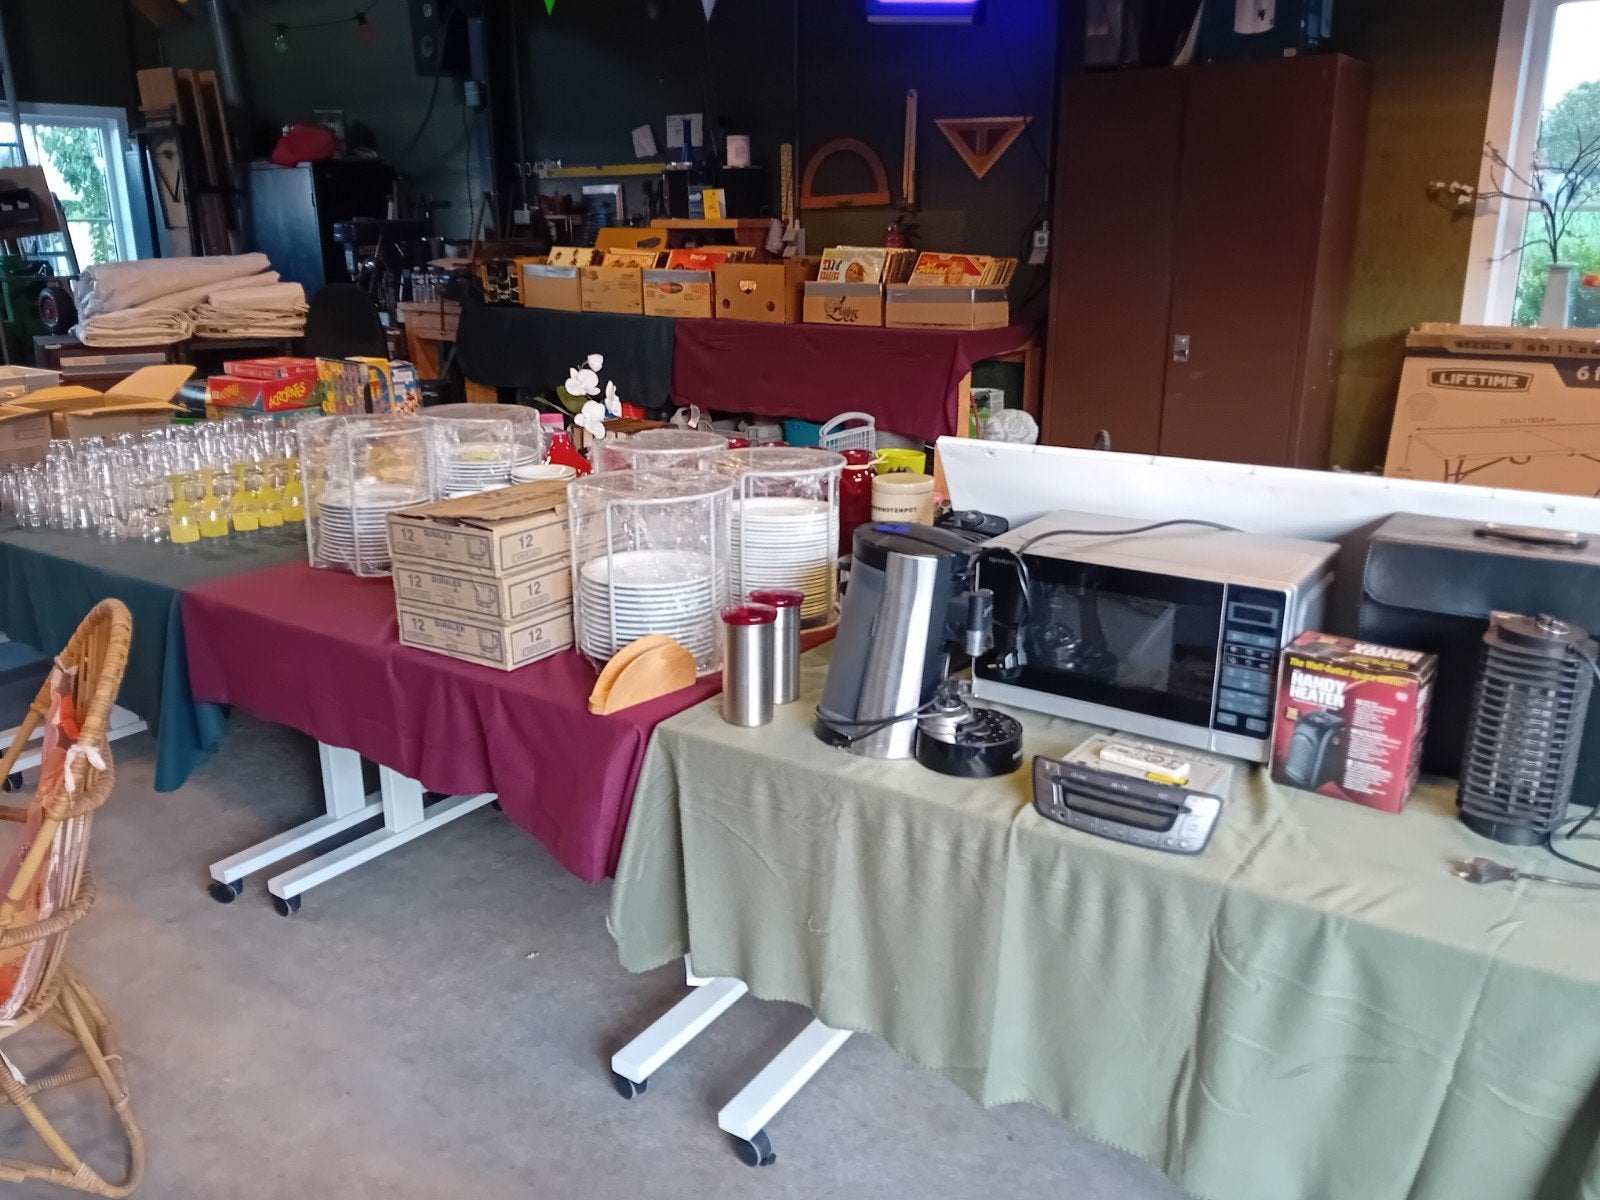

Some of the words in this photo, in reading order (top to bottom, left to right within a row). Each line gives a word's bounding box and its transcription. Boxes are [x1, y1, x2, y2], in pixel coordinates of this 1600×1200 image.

[1439, 372, 1519, 388] LIFETIME
[1576, 366, 1590, 381] 6
[401, 527, 415, 542] 12
[519, 534, 534, 549] 12
[408, 574, 422, 588] 12
[527, 581, 541, 596] 12
[411, 618, 425, 631] 12
[529, 628, 543, 642] 12
[1290, 657, 1304, 667] The
[1291, 669, 1347, 695] HANDY
[1289, 684, 1345, 709] HEATER
